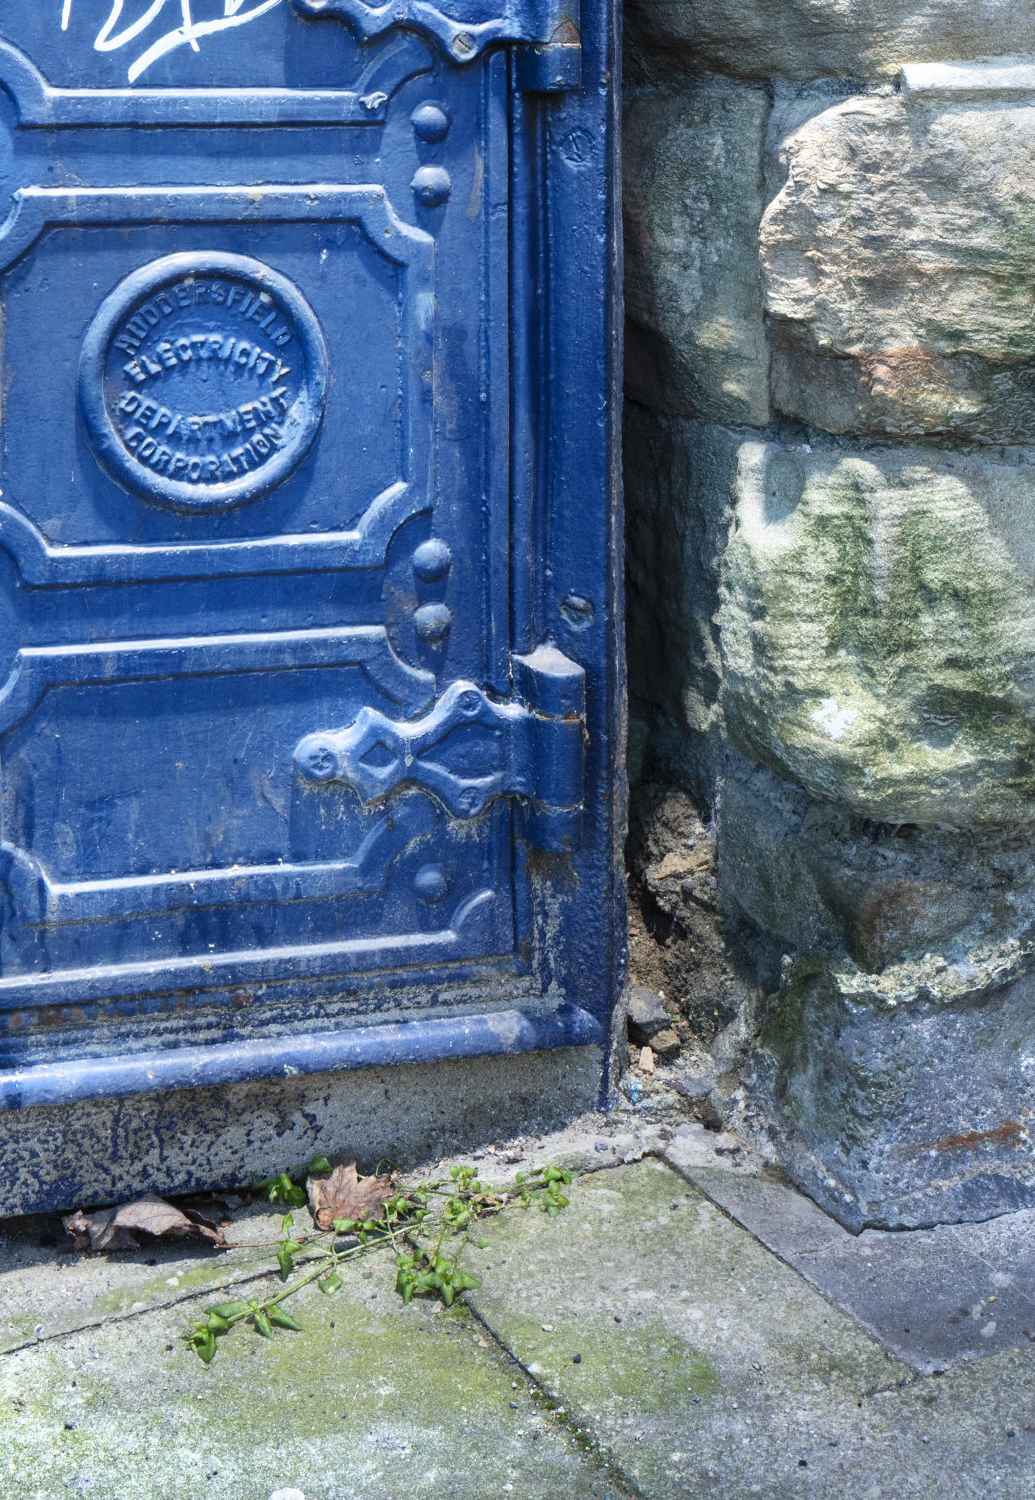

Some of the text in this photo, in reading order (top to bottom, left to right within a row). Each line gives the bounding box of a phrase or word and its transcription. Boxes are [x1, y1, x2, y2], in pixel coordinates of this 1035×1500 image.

[117, 281, 292, 355] HUDDERSFIELD
[122, 333, 292, 384] ELECTRICITY
[118, 386, 289, 438] DEPARTMENT
[125, 423, 286, 482] CORPORATION
